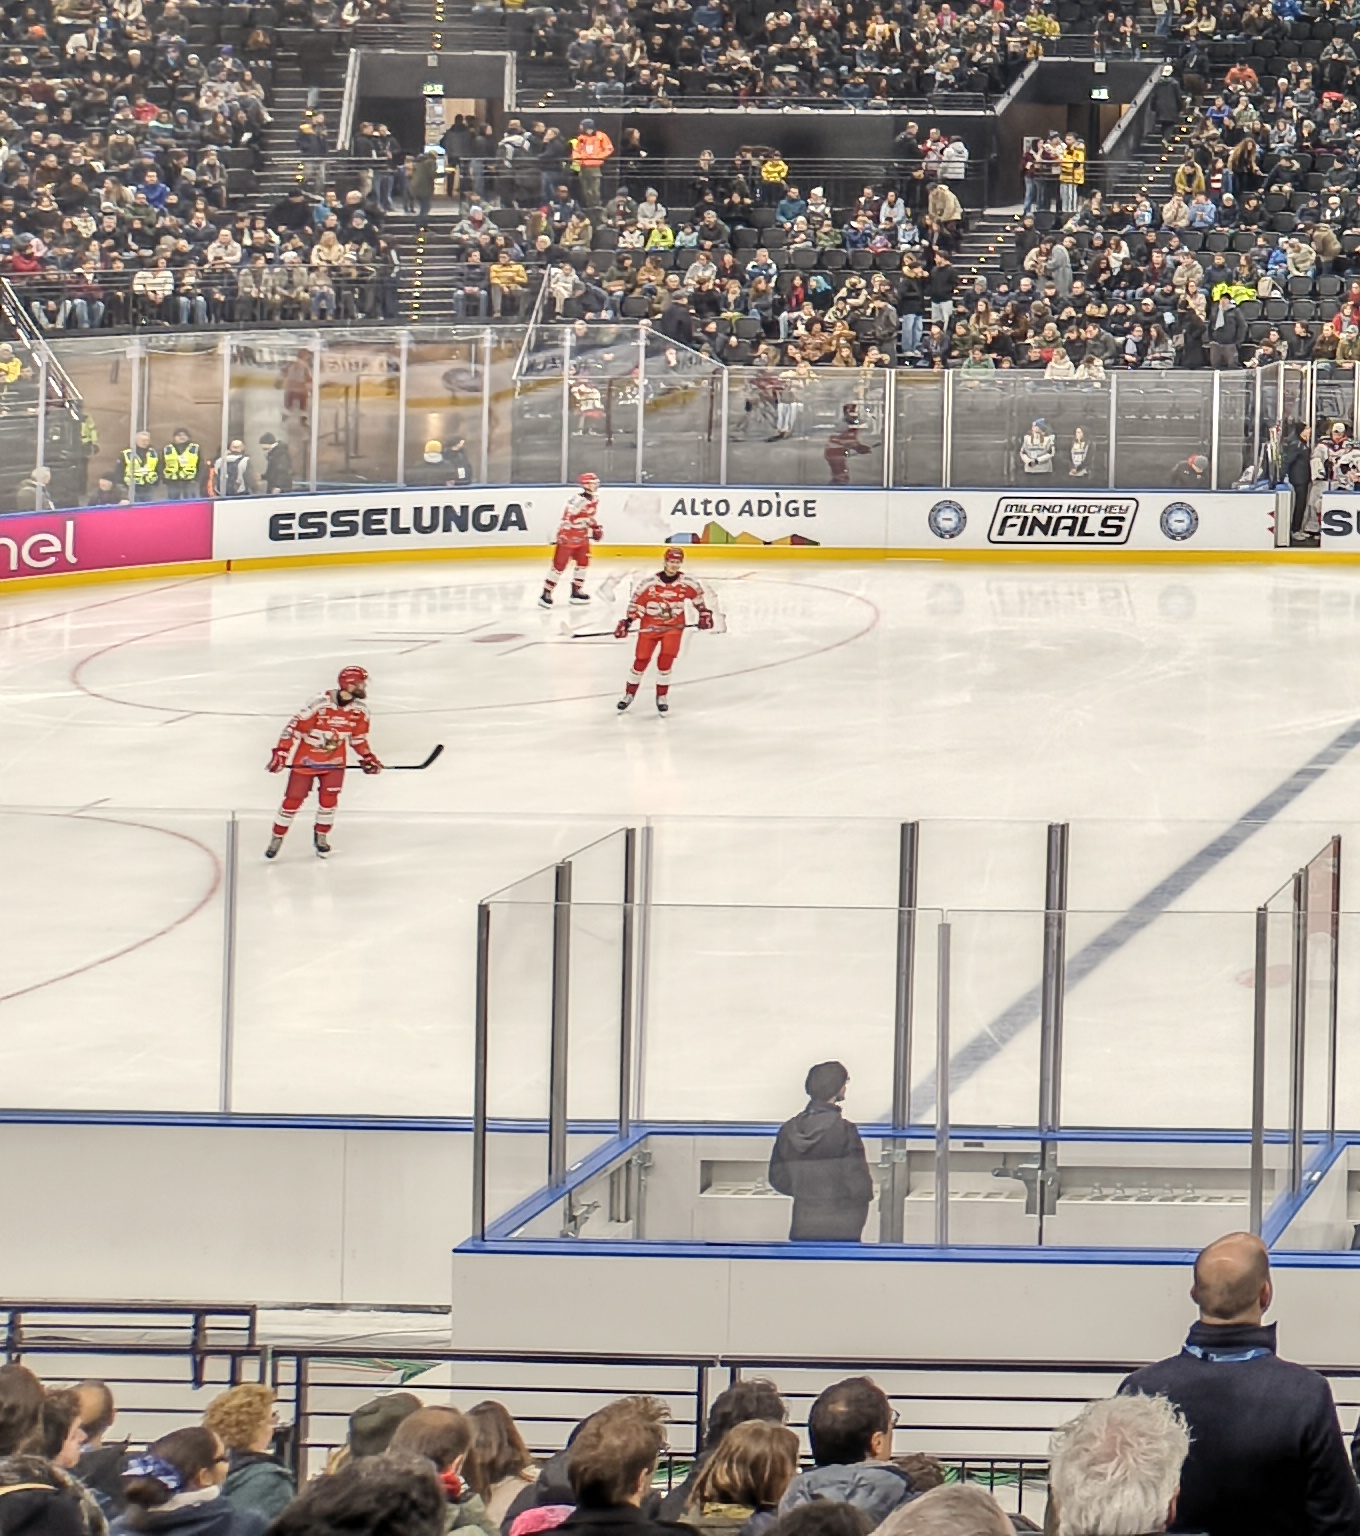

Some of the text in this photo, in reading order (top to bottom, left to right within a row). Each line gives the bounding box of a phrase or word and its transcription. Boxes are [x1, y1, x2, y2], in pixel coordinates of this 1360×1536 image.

[269, 502, 529, 542] ESSELUNGA
[1004, 504, 1129, 515] MILANO HOCKEY
[997, 515, 1126, 537] FINALS
[0, 519, 78, 572] nel
